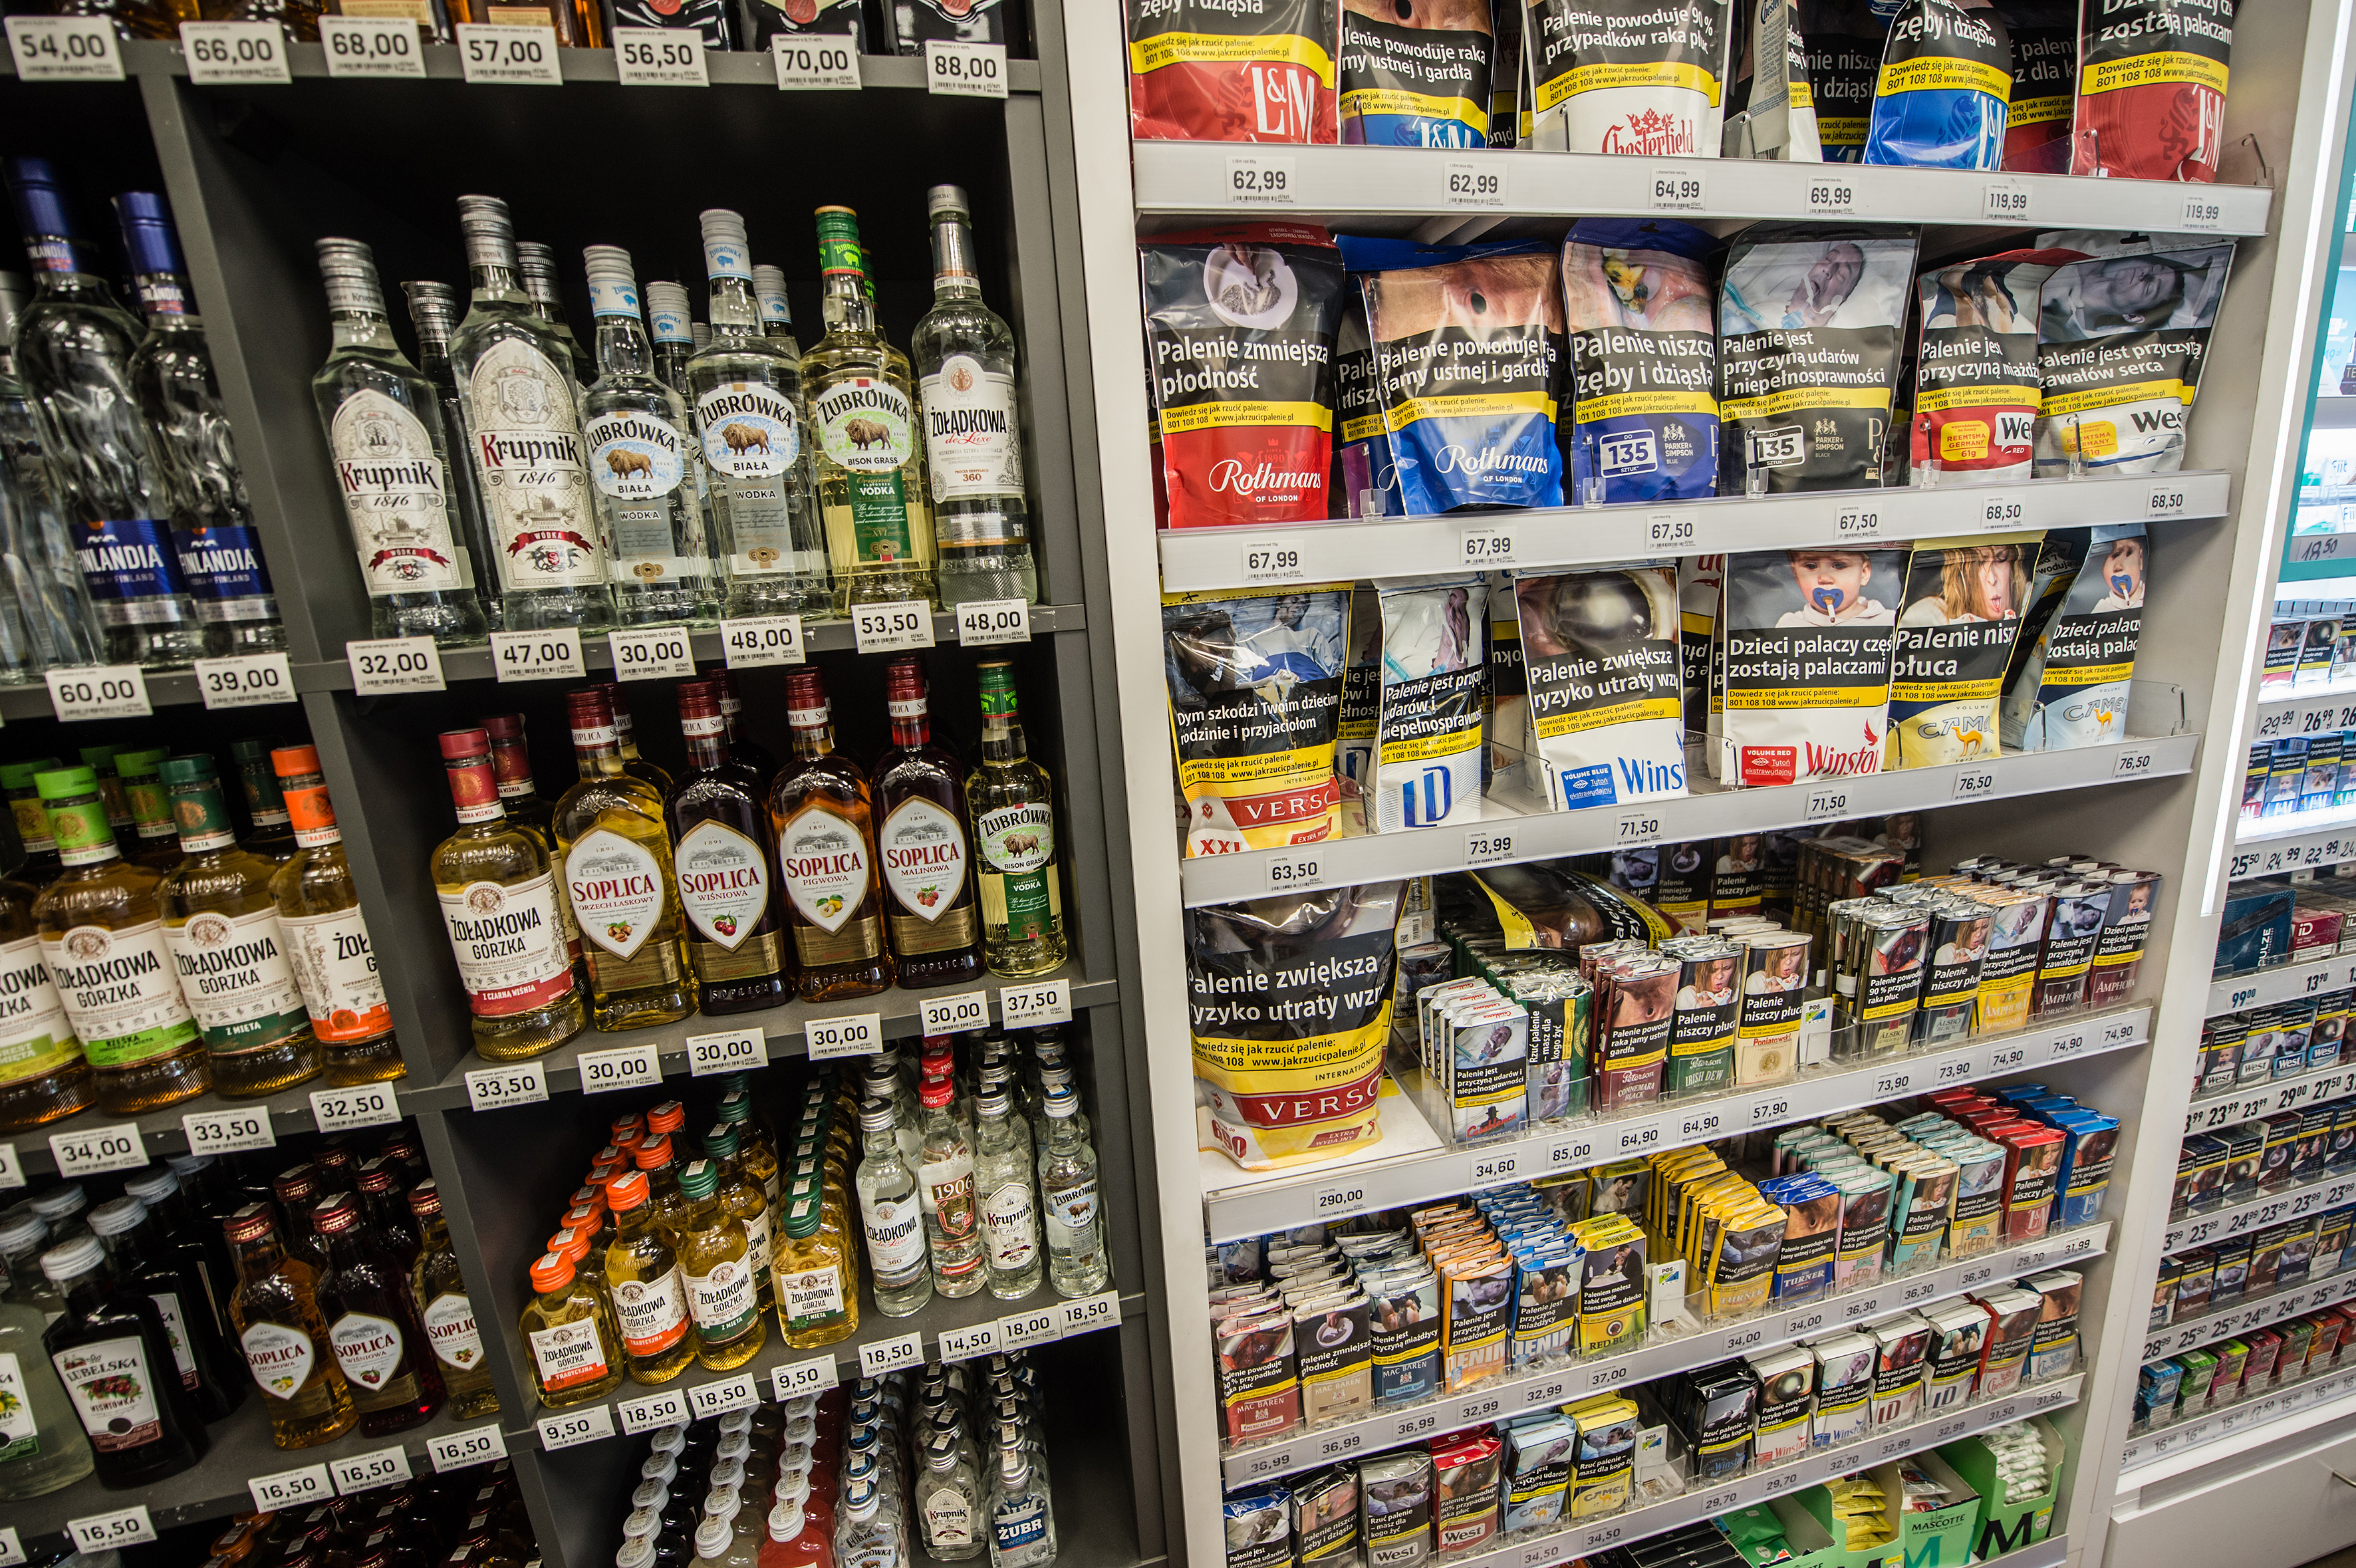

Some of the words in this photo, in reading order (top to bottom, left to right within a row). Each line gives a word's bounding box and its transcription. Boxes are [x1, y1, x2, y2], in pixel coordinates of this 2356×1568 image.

[1543, 8, 1602, 36] Palenie
[1606, 7, 1688, 30] powoduje
[1895, 17, 1942, 41] zęby
[20, 34, 105, 63] 54,00
[332, 33, 408, 61] 68,00
[469, 40, 542, 66] 57,00
[624, 44, 692, 68] 56,50
[1143, 36, 1174, 53] Dowiedz
[1176, 37, 1187, 48] się
[1189, 37, 1200, 49] jak
[1201, 39, 1222, 47] rzucić
[1225, 39, 1255, 49] palenie:
[1545, 30, 1646, 65] przypadków
[1650, 30, 1692, 45] raka
[1694, 30, 1708, 55] płuc
[1145, 54, 1157, 65] 801
[1160, 49, 1174, 59] 108
[1193, 48, 1289, 59] www.jakrzucicpalenie.pl
[934, 56, 997, 81] 88,00
[1233, 170, 1286, 194] 62,99
[1655, 180, 1700, 201] 64,99
[1811, 187, 1851, 207] 69,99
[1990, 194, 2027, 210] 119,99
[1158, 336, 1238, 364] Palenie
[1244, 339, 1329, 366] zmniejsza
[1573, 329, 1654, 361] Palenie
[1723, 332, 1783, 354] Palenie
[1787, 331, 1814, 350] jest
[1921, 337, 1981, 359] Palenie
[1984, 338, 2002, 356] jest
[1724, 349, 1806, 379] przyczyną
[1808, 348, 1859, 365] udarów
[1162, 365, 1258, 402] płodność
[1577, 362, 1633, 395] zęby
[1652, 360, 1712, 391] dziąsła
[1734, 368, 1885, 394] niepełnosprawności
[699, 394, 793, 430] ŻUBRÓWKA
[817, 389, 908, 425] ŻUBRÓWKA
[930, 406, 1007, 438] ŻOŁĄDKOWA
[481, 434, 582, 467] Krupnik
[1608, 442, 1648, 465] 135
[1949, 440, 1984, 448] GERMANY
[1961, 450, 1976, 459] 61g
[733, 461, 769, 471] BIAŁA
[848, 457, 872, 465] BISON
[1435, 445, 1548, 475] Rothmans
[339, 463, 438, 493] Krupnik
[517, 471, 556, 484] 1846
[963, 473, 982, 482] 360
[1209, 459, 1321, 493] Rothmans
[374, 495, 408, 507] 1846
[859, 487, 895, 495] VODKA
[1839, 513, 1877, 532] 67,50
[1986, 505, 2021, 523] 68,50
[1652, 523, 1693, 541] 67,50
[1249, 551, 1297, 573] 67,99
[861, 614, 918, 634] 53,50
[964, 612, 1020, 632] 48,00
[620, 641, 684, 666] 30,00
[1730, 636, 1789, 656] Dzieci
[1794, 635, 1859, 656] palaczy
[360, 652, 428, 677] 32,00
[1530, 660, 1597, 686] Palenie
[1602, 646, 1673, 672] zwiększa
[1730, 658, 1799, 680] zostają
[1805, 658, 1885, 679] palaczami
[1892, 657, 1957, 680] płuca
[60, 679, 134, 704] 60,00
[207, 668, 279, 694] 39,00
[1533, 684, 1593, 711] ryzyko
[1597, 672, 1654, 695] utraty
[1178, 710, 1204, 726] Dym
[1208, 704, 1258, 720] szkodzi
[1261, 700, 1299, 718] Twoim
[1302, 694, 1338, 710] dzieciom
[1180, 727, 1230, 745] rodzinie
[1242, 717, 1317, 741] przyjaciołom
[2119, 755, 2150, 771] 76,50
[1959, 775, 1992, 792] 76,50
[980, 809, 1051, 838] ŻUBRÓWKA
[1621, 820, 1658, 839] 71,50
[886, 842, 960, 868] SOPLICA
[1470, 837, 1511, 856] 73,99
[787, 851, 862, 879] SOPLICA
[901, 864, 950, 876] MALINOWA
[1272, 862, 1317, 882] 63,50
[573, 873, 656, 902] SOPLICA
[682, 866, 761, 894] SOPLICA
[803, 874, 848, 886] PIGWOWA
[579, 901, 612, 912] ORZECH
[614, 896, 654, 908] LASKOWY
[698, 889, 748, 901] WIŚNIOWA
[450, 907, 541, 942] ŻOŁĄDKOWA
[176, 937, 278, 976] ŻOŁĄDKOWA
[473, 937, 526, 960] GORZKA
[199, 970, 261, 995] GORZKA
[1275, 955, 1378, 987] zwiększa
[1008, 990, 1057, 1012] 37,50
[1269, 994, 1338, 1021] utraty
[928, 1003, 980, 1024] 30,00
[2053, 1037, 2083, 1053] 74,90
[589, 1058, 647, 1081] 30,00
[1315, 1056, 1376, 1081] INTERNATIONAL
[1485, 1067, 1498, 1077] jest
[1686, 1074, 1703, 1087] IRISH
[1705, 1070, 1724, 1081] DEW
[476, 1076, 535, 1099] 33,50
[1754, 1101, 1787, 1120] 57,90
[194, 1118, 259, 1144] 33,50
[63, 1137, 132, 1164] 34,00
[1553, 1144, 1591, 1162] 85,00
[1476, 1160, 1515, 1178] 34,60
[935, 1174, 973, 1200] 1906
[1319, 1190, 1363, 1208] 290,00
[987, 1203, 1032, 1227] Krupnik
[865, 1214, 916, 1243] ŻOŁĄDKOWA
[1845, 1299, 1877, 1317] 36,30
[1006, 1317, 1051, 1337] 18,00
[543, 1341, 592, 1362] ŻOŁĄDKOWA
[946, 1332, 991, 1353] 14,50
[555, 1365, 593, 1380] TRADYCYJNA
[557, 1355, 584, 1367] GORZKA
[1592, 1368, 1627, 1385] 37,00
[626, 1401, 676, 1425] 18,50
[547, 1420, 590, 1441] 9,50
[79, 1517, 140, 1545] 16,50
[998, 1518, 1043, 1539] ŻUBR
[1912, 1514, 1965, 1531] MASCOTTE
[1445, 1527, 1482, 1542] West
